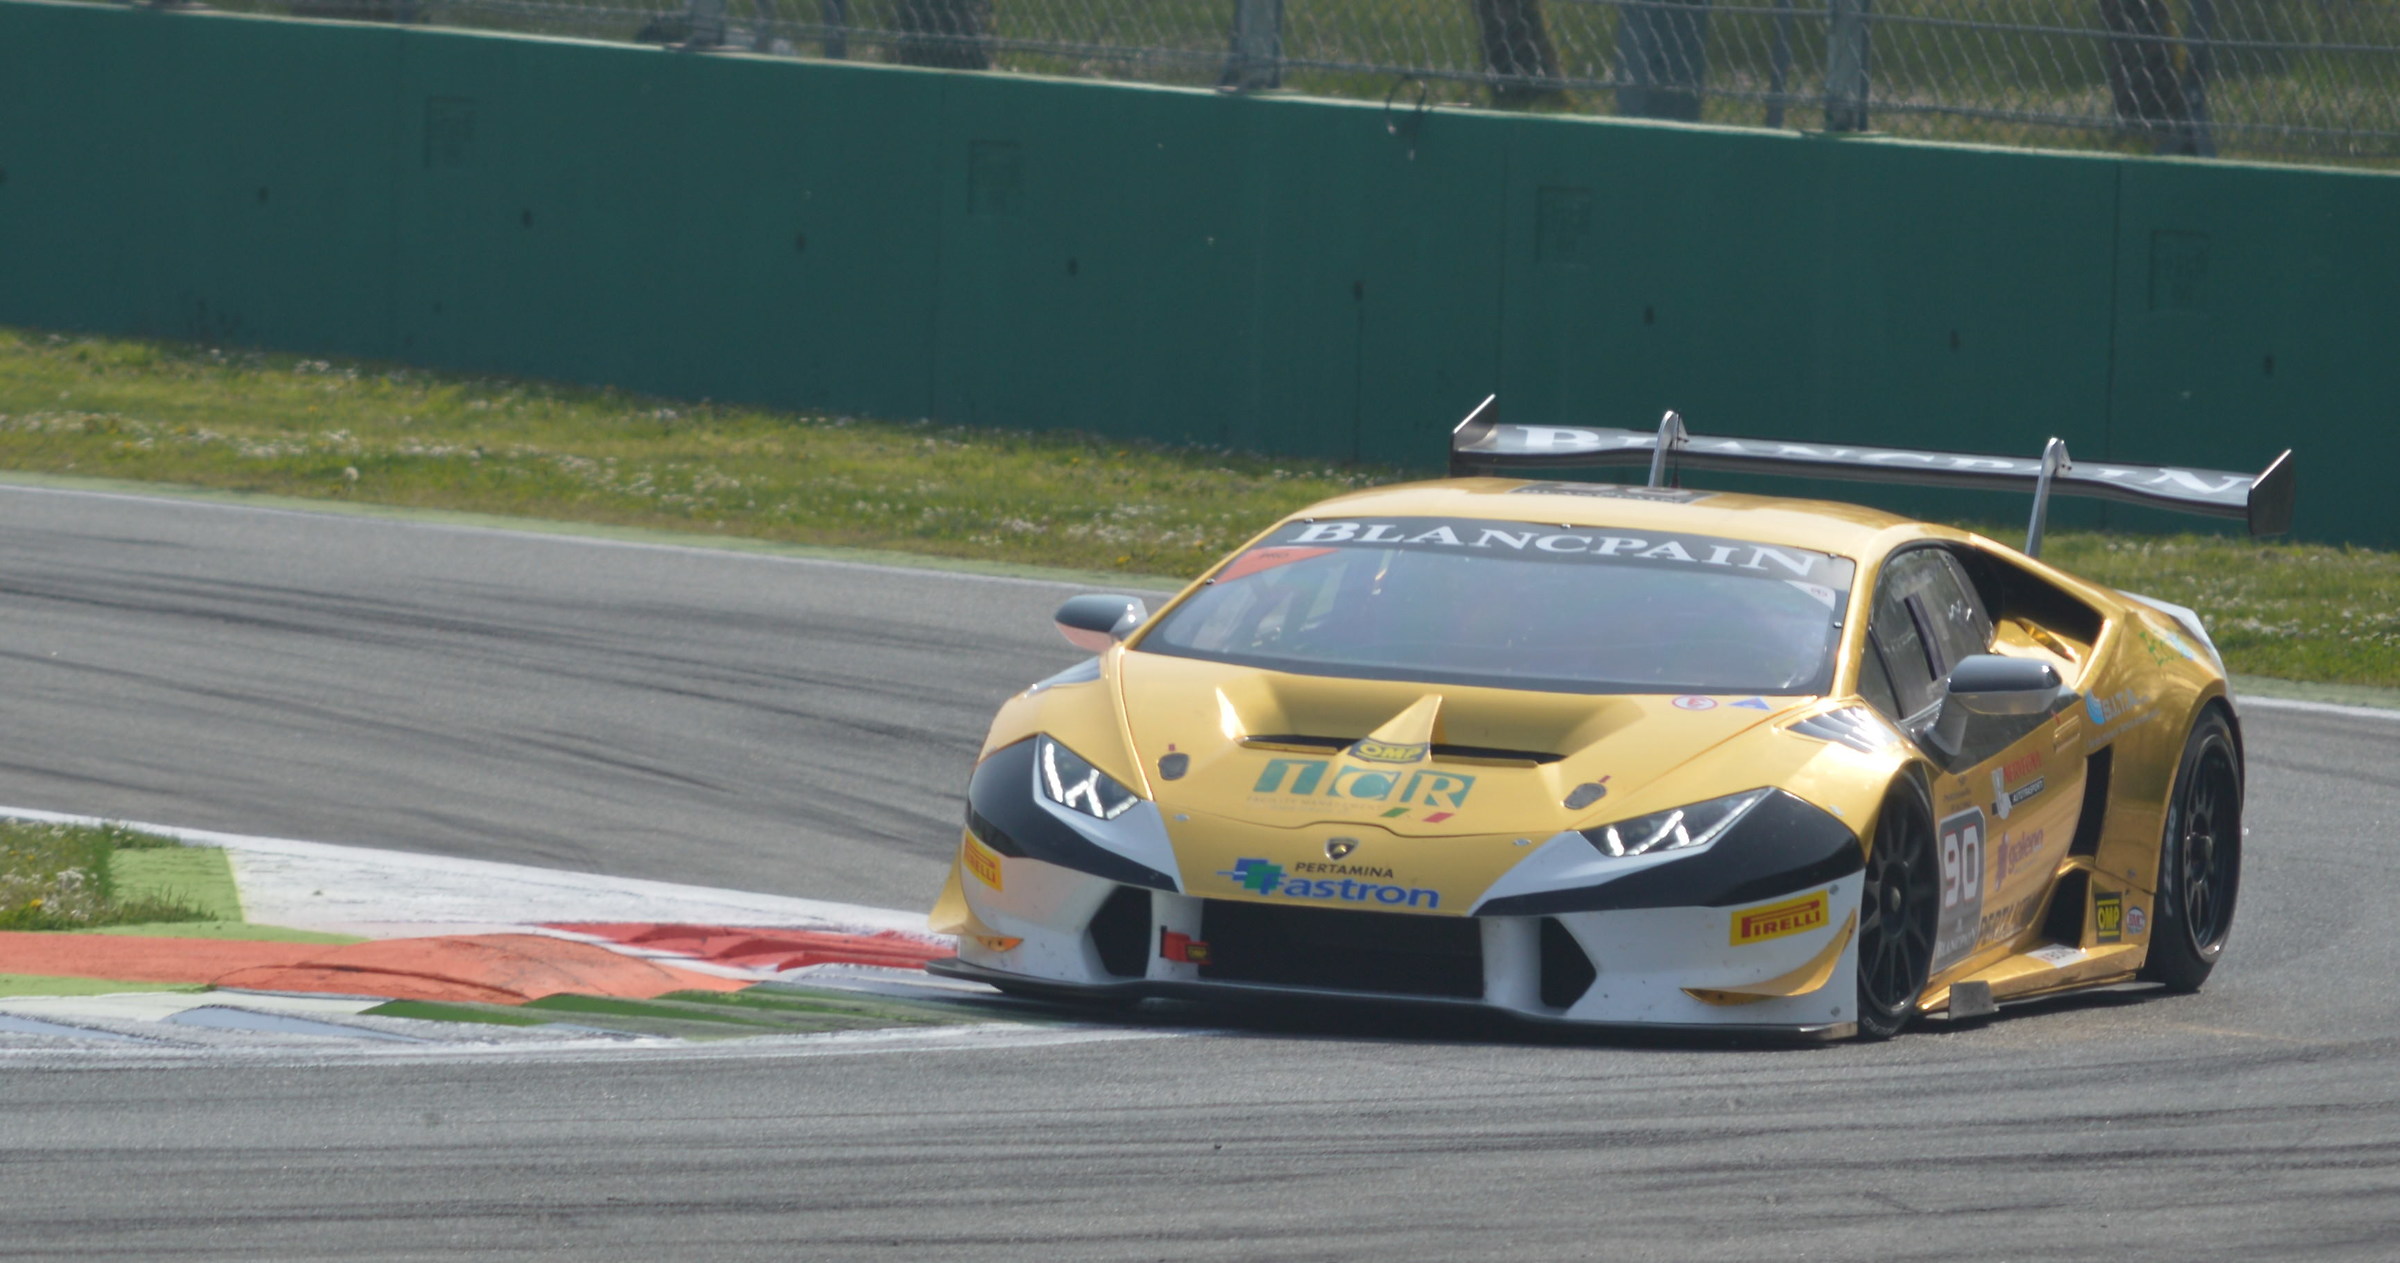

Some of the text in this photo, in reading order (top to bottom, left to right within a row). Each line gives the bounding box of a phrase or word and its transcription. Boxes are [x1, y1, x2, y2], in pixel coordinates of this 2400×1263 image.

[1287, 522, 1816, 577] BLANCPAIN
[1359, 743, 1423, 759] OMP
[1295, 861, 1394, 879] PERTAMINA
[1943, 823, 1979, 911] 90
[1741, 899, 1820, 938] PIRELLI
[2097, 905, 2120, 930] OMP
